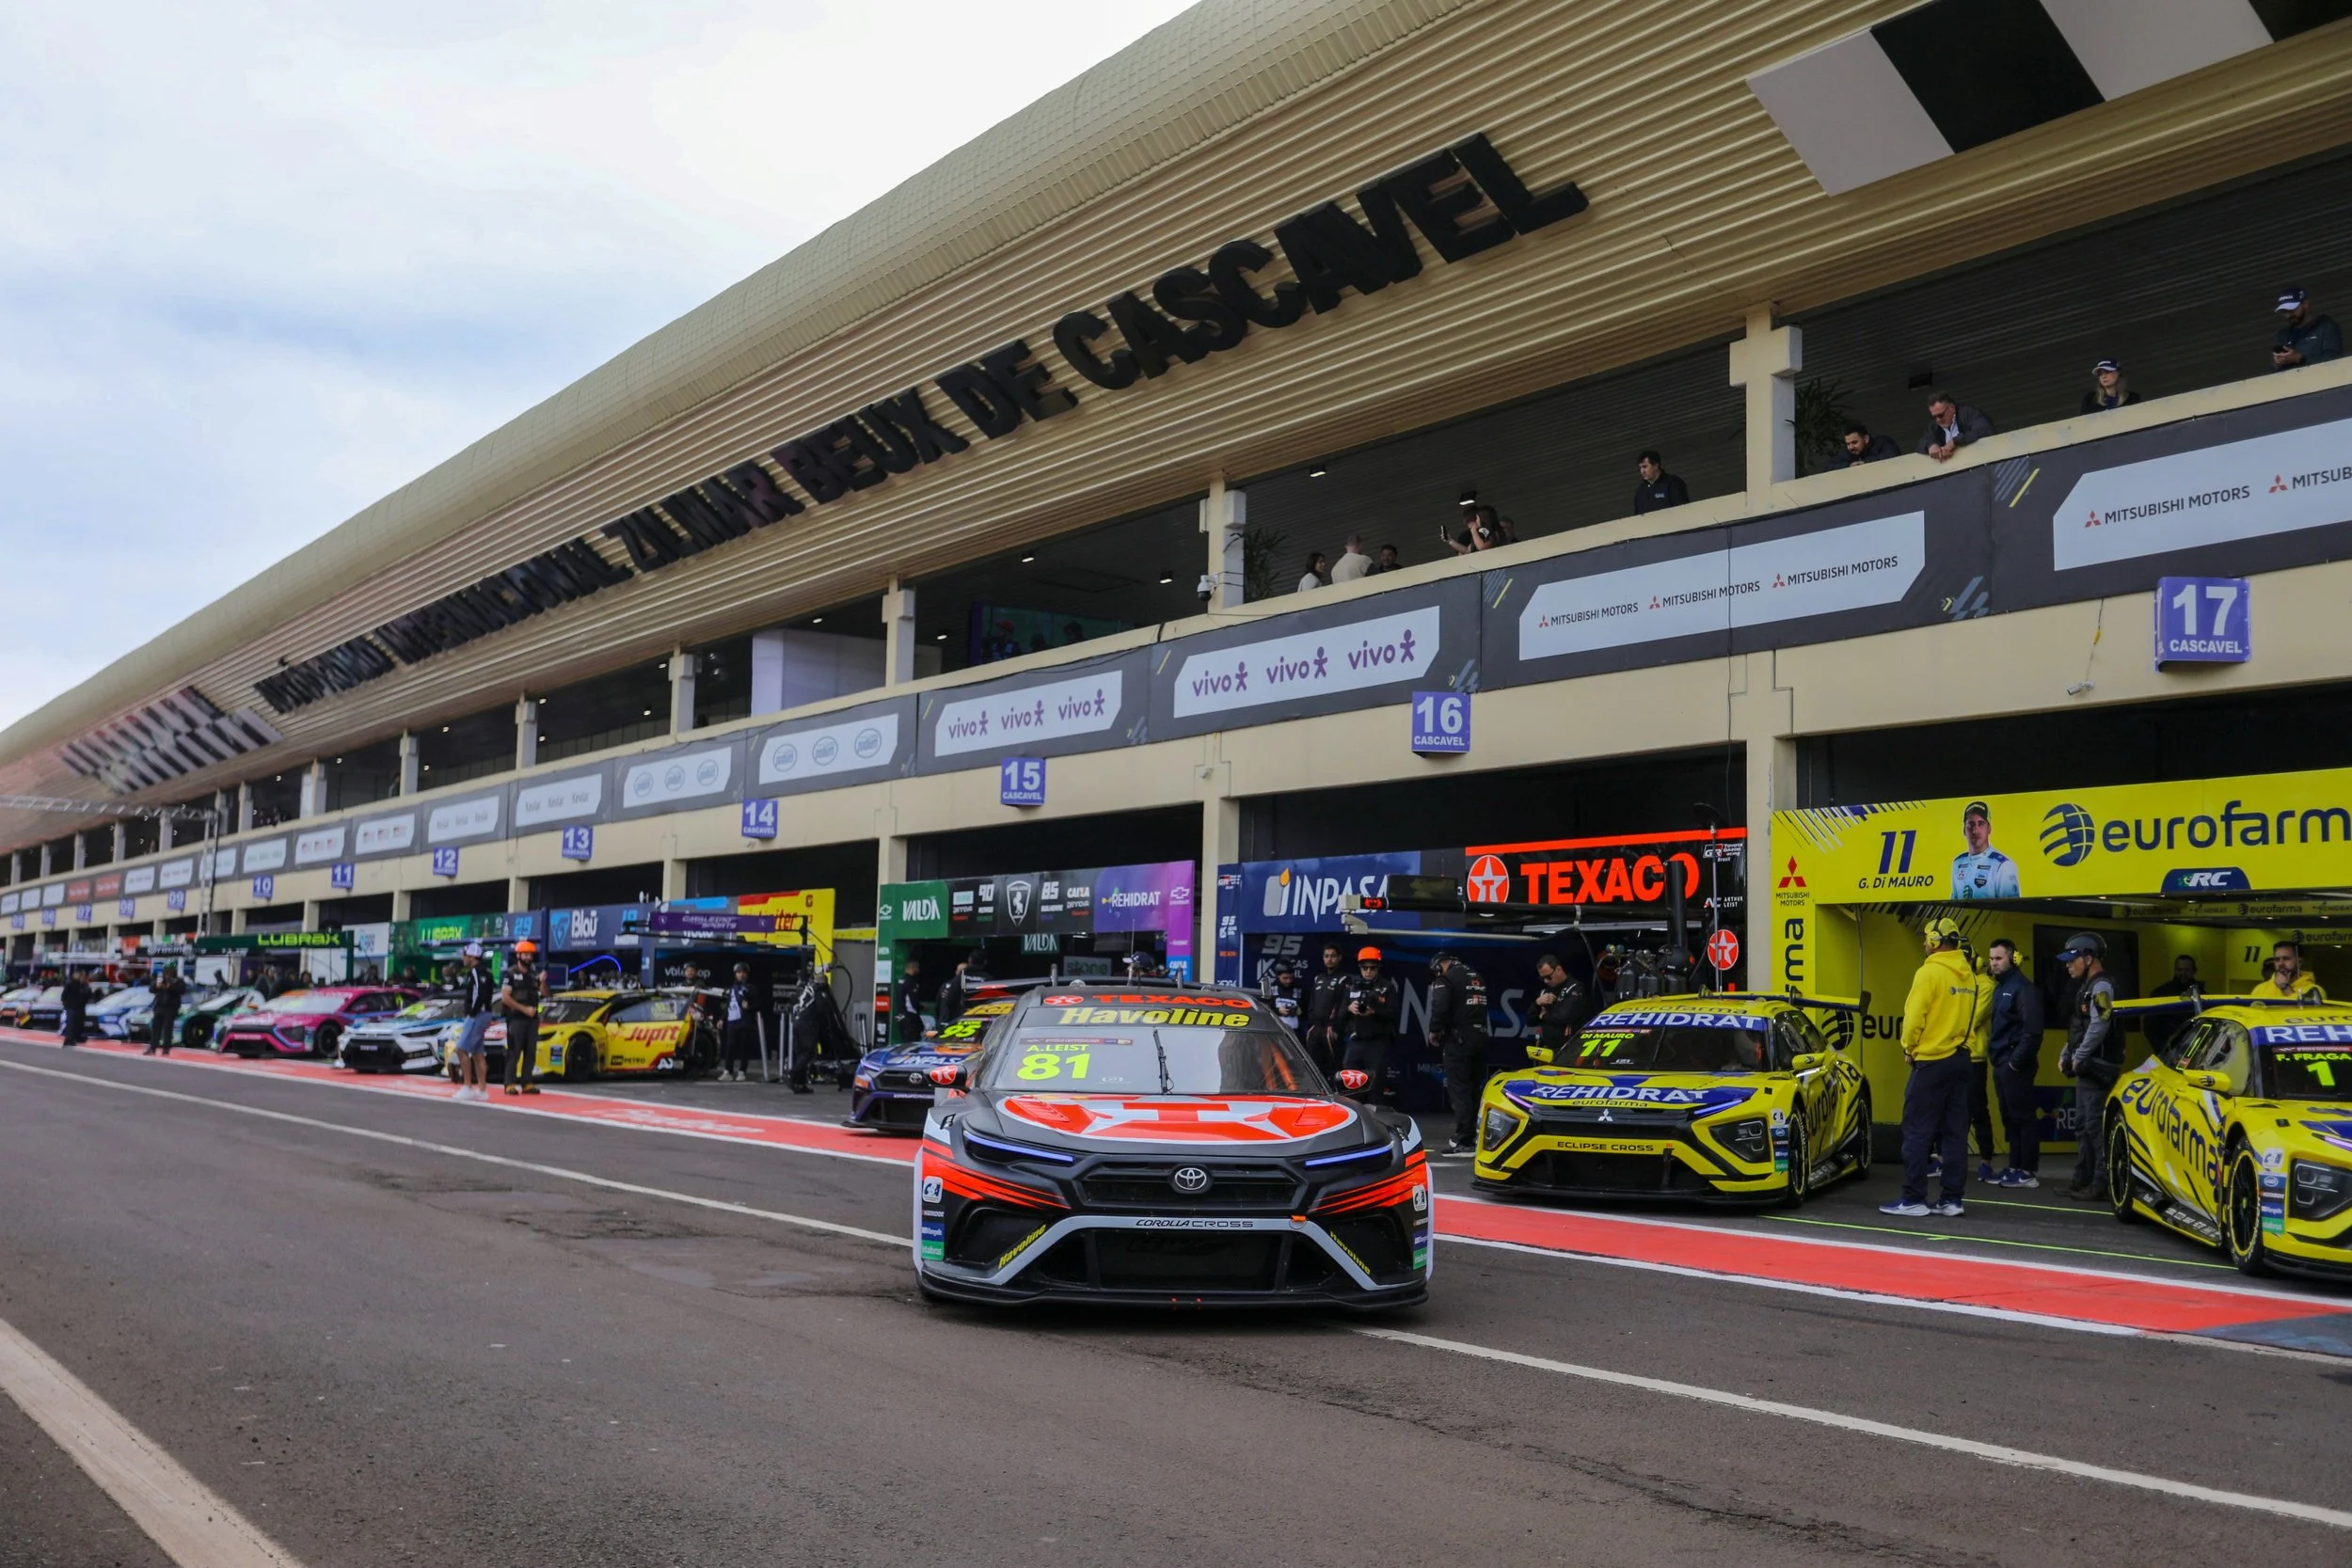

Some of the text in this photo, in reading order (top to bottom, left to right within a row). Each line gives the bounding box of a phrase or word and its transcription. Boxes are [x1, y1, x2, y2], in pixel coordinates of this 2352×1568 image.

[770, 387, 971, 506] BEUX
[934, 339, 1081, 440] DE
[1053, 131, 1591, 391] CASCAVEL
[2105, 498, 2185, 525] MITSUBISHI
[2188, 484, 2250, 509] MOTORS
[1550, 556, 1899, 626] MITSUBISHI MOTORS MITSUBISHI MOTORS MITSUBISHI MOTORS
[2173, 584, 2237, 636] 17
[2169, 640, 2243, 654] CASCAVEL
[1192, 641, 1396, 697] vivo vivo vivo
[948, 696, 1091, 739] vivo vivo vivo
[1416, 696, 1463, 734] 16
[1414, 736, 1465, 747] CASCAVEL
[1005, 761, 1041, 791] 15
[1003, 791, 1042, 800] CASCAVEL
[745, 801, 775, 826] 14
[2102, 800, 2352, 853] eurofarm
[564, 829, 590, 847] 13
[434, 850, 456, 867] 12
[1878, 830, 1917, 875] 11
[334, 865, 352, 881] 11
[1520, 852, 1700, 904] TEXACO
[2189, 871, 2232, 887] RC
[254, 877, 272, 893] 10
[1041, 881, 1059, 899] 85
[1858, 879, 1868, 889] G.
[1888, 875, 1934, 888] MAURO
[168, 891, 184, 908] 09
[978, 884, 994, 902] 90
[1067, 887, 1089, 898] CAIXA
[1111, 892, 1161, 908] REHIDRAT
[2249, 903, 2303, 913] eurofarma
[258, 932, 340, 946] LUBRAX
[1262, 935, 1304, 955] 95
[2244, 945, 2262, 963] 11
[1067, 959, 1108, 976] stone
[1092, 994, 1253, 1008] TEXACO
[1619, 1005, 1747, 1014] eurofarma
[1059, 1006, 1250, 1028] Havoline
[1589, 1013, 1762, 1029] REHIDRAT
[939, 1023, 982, 1038] 95
[1026, 1044, 1089, 1053] A.LEIST
[1580, 1039, 1622, 1057] 11
[904, 1055, 962, 1065] INPAS
[1016, 1053, 1090, 1081] 81
[2307, 1061, 2335, 1086] 1
[1531, 1085, 1709, 1101] REHIDRAT
[1572, 1099, 1648, 1108] eurofarma
[2121, 1078, 2220, 1188] eurofarma
[1557, 1141, 1655, 1152] ECLIPSE CROSS
[1136, 1219, 1190, 1227] COROLLA
[998, 1224, 1046, 1270] Havoline
[1329, 1230, 1371, 1275] Havoline
